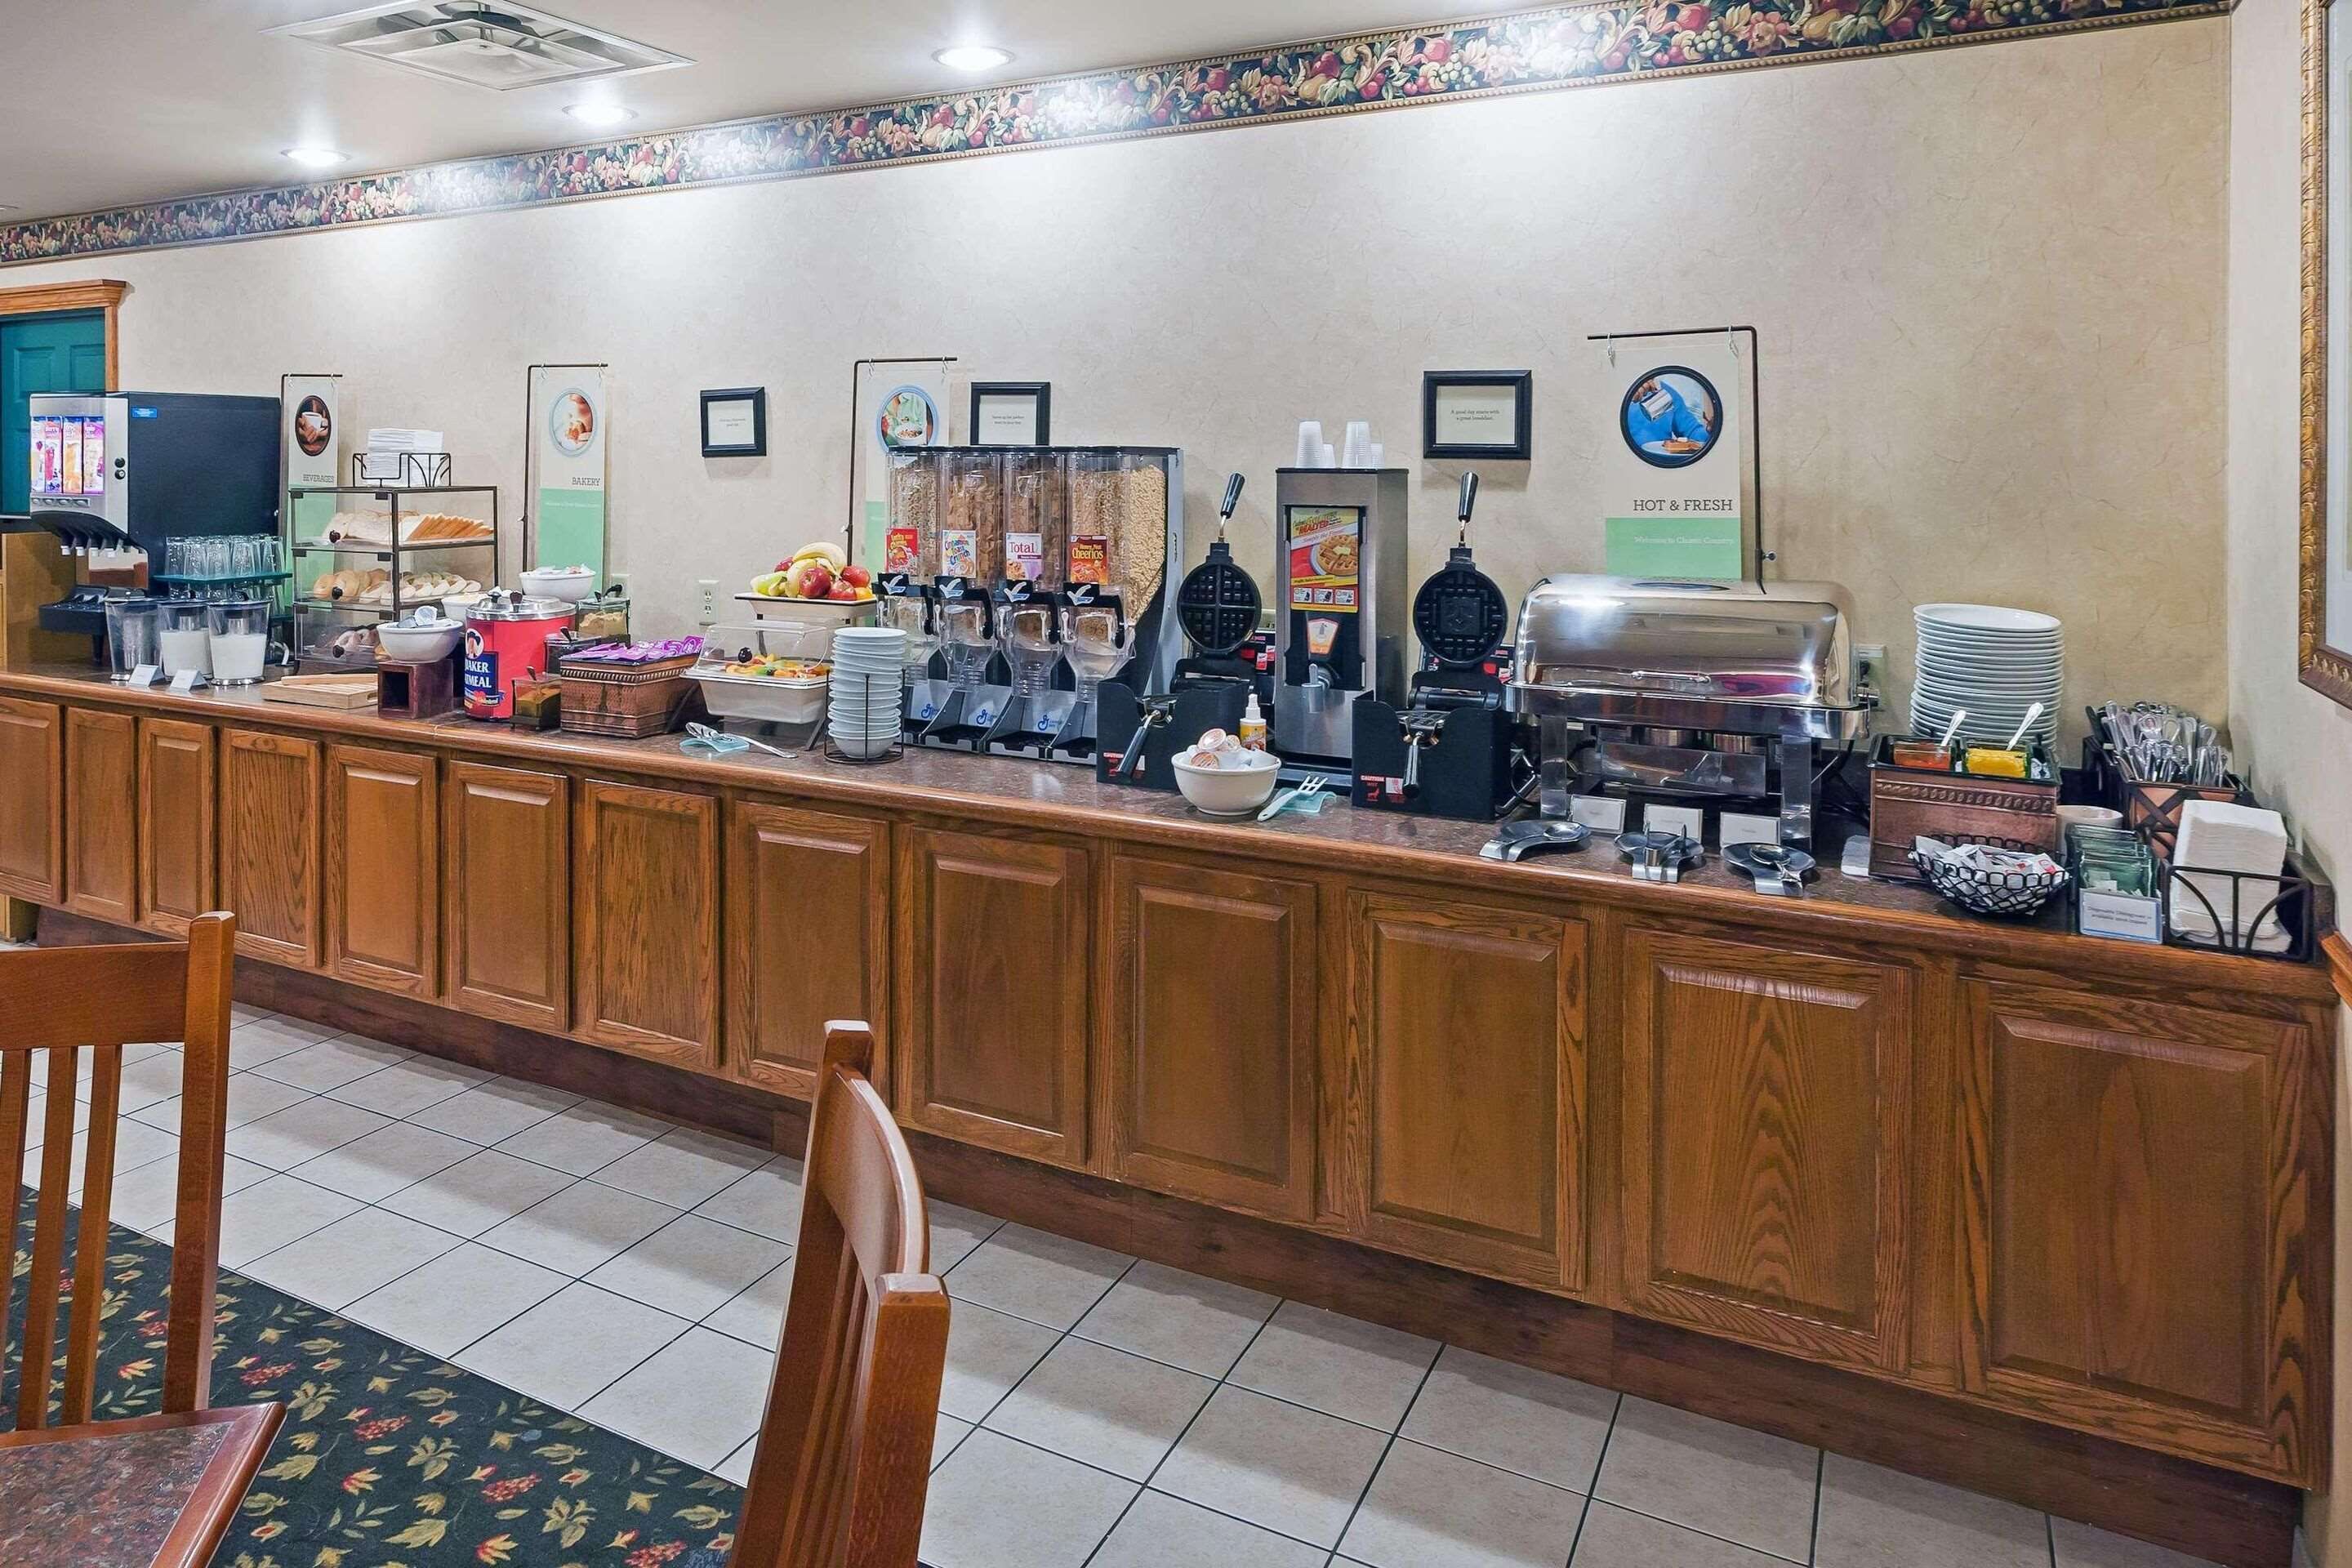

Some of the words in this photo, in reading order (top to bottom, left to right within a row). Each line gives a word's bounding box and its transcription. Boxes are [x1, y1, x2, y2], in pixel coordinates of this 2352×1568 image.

[572, 477, 600, 486] BAKERY
[1633, 499, 1666, 511] HOT
[1669, 500, 1680, 511] &
[1683, 499, 1733, 511] FRESH
[1009, 541, 1035, 554] Total
[1071, 547, 1103, 559] Cheerios
